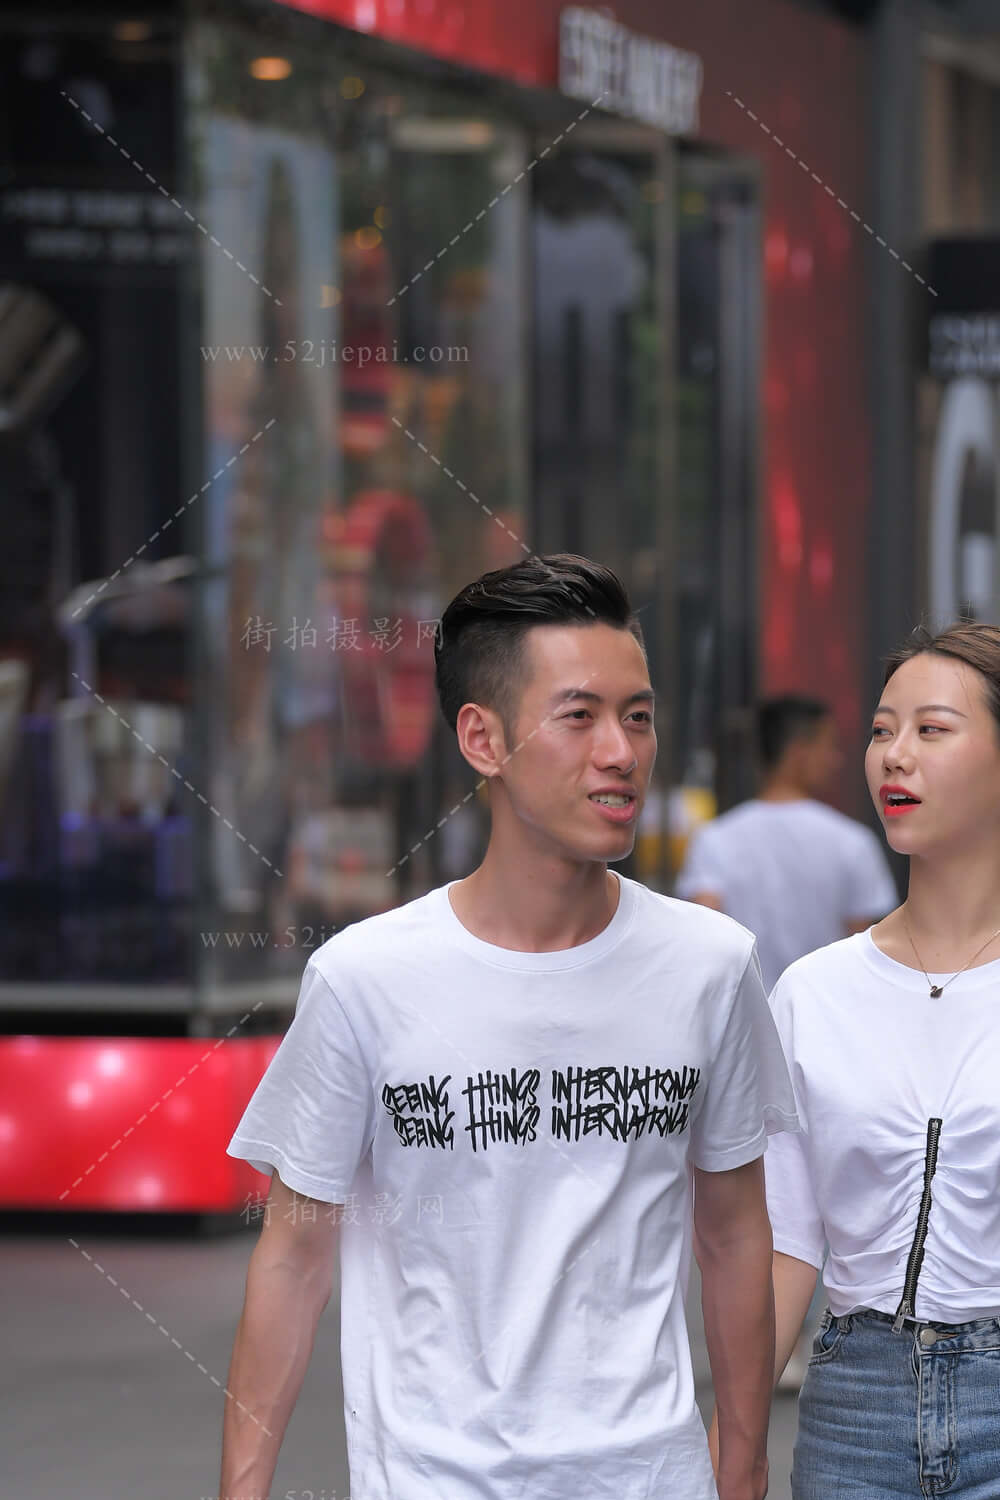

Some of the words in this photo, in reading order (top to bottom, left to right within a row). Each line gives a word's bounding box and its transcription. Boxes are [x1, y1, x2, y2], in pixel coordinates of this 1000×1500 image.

[382, 1075, 452, 1116] SEEING
[462, 1067, 541, 1112] THINGS
[393, 1110, 456, 1151] SEEING
[464, 1105, 541, 1152] THINGS
